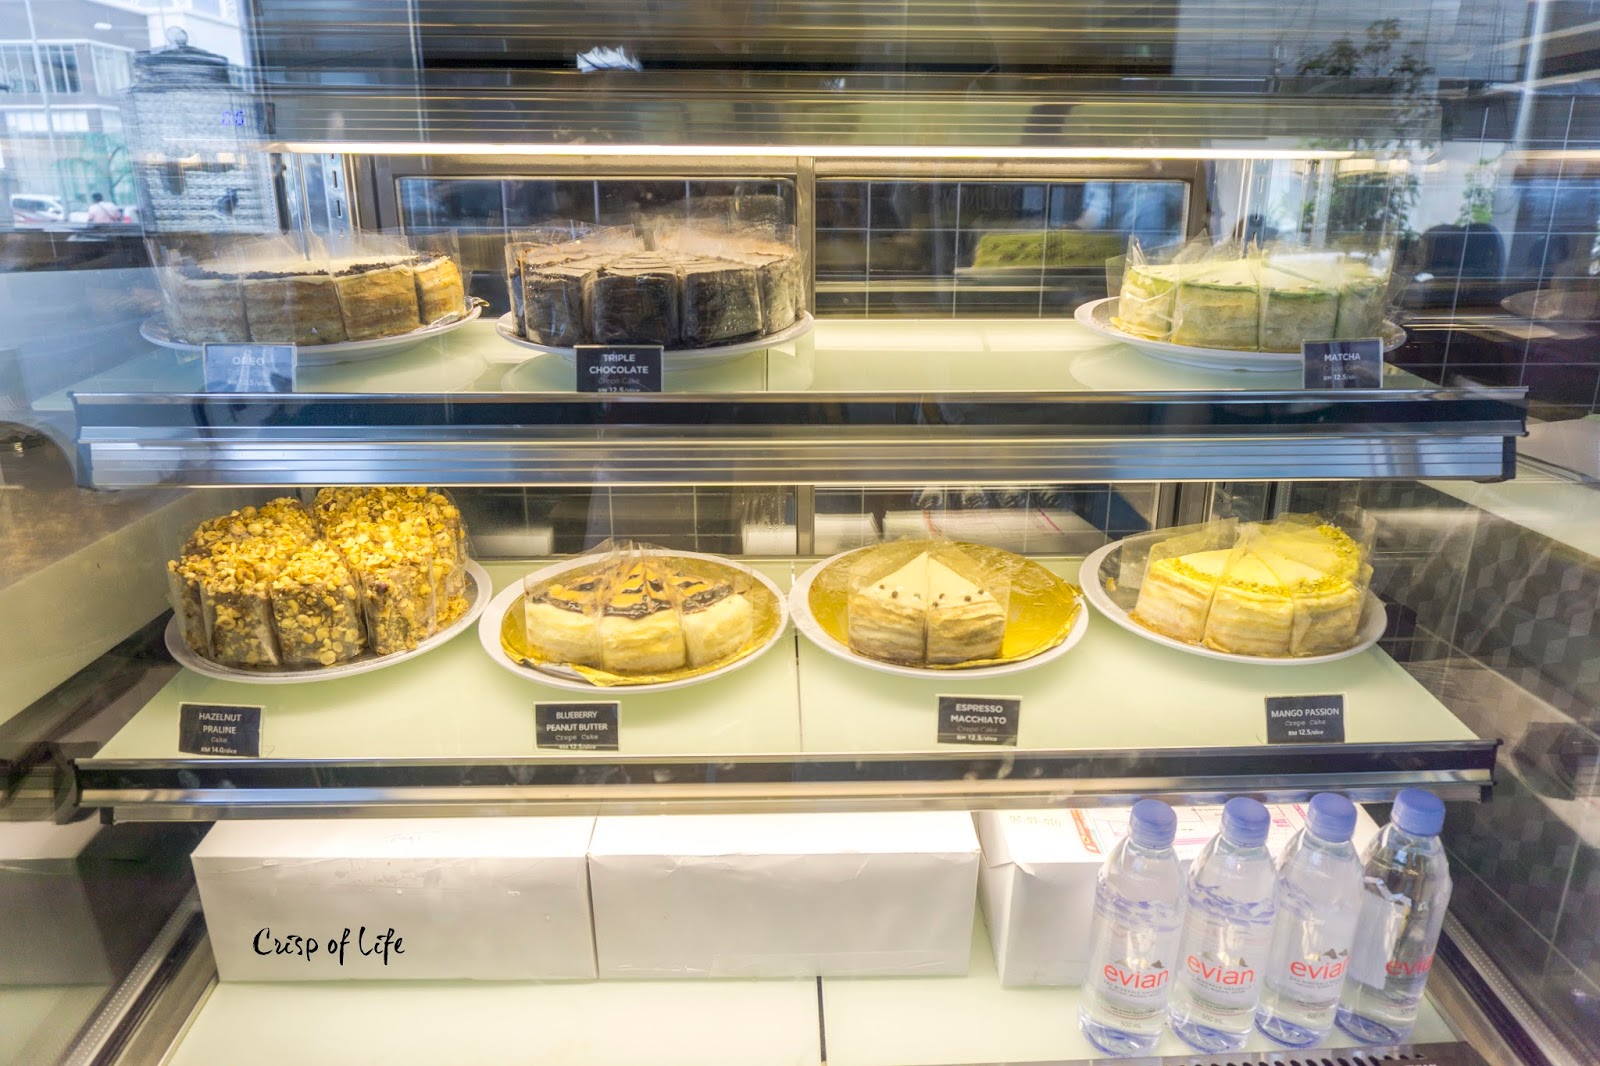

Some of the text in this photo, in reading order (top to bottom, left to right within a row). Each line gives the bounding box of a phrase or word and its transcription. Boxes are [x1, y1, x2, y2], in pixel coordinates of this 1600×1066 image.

[232, 356, 264, 366] OREO
[602, 354, 636, 362] TRIPLE
[1324, 353, 1361, 361] MATCHA
[589, 366, 649, 374] CHOCOLATE
[956, 704, 1004, 714] ESPRESSO
[1271, 708, 1340, 718] MANGO PASSION
[199, 713, 242, 722] HAZELNUT
[556, 711, 598, 720] BLUEBERRY
[950, 714, 1007, 725] MACCHIATO
[203, 725, 237, 735] PRALINE
[546, 723, 608, 732] PEANUT BUTTER
[1187, 955, 1254, 985] evian
[1103, 964, 1169, 989] evian
